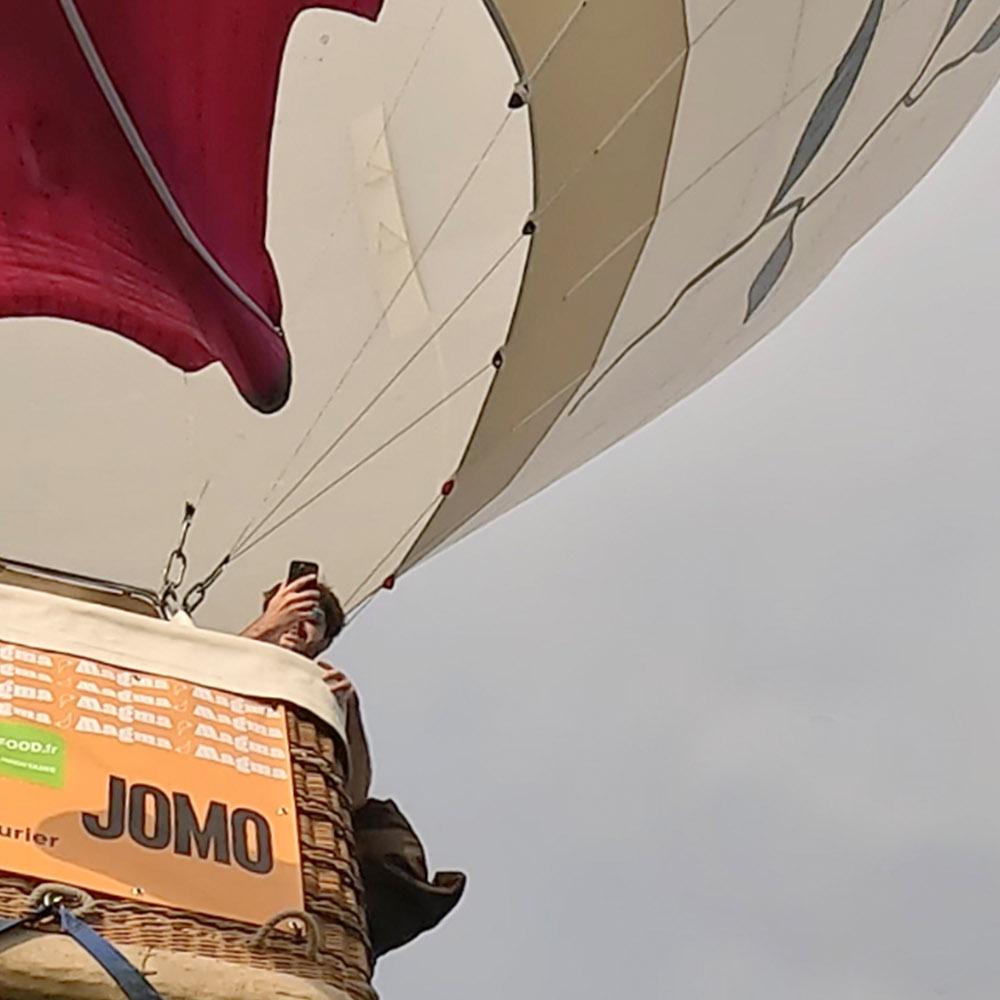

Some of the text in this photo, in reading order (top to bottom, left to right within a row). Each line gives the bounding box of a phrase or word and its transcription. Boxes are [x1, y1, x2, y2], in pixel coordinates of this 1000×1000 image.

[75, 660, 170, 690] Magma
[192, 687, 282, 718] Magma
[75, 680, 172, 708] Magma
[193, 705, 284, 738] Magma
[74, 716, 173, 750] Magma
[194, 744, 288, 780] Magma
[76, 696, 173, 728] Magma
[193, 722, 286, 759] Magma
[81, 774, 274, 875] JOMO
